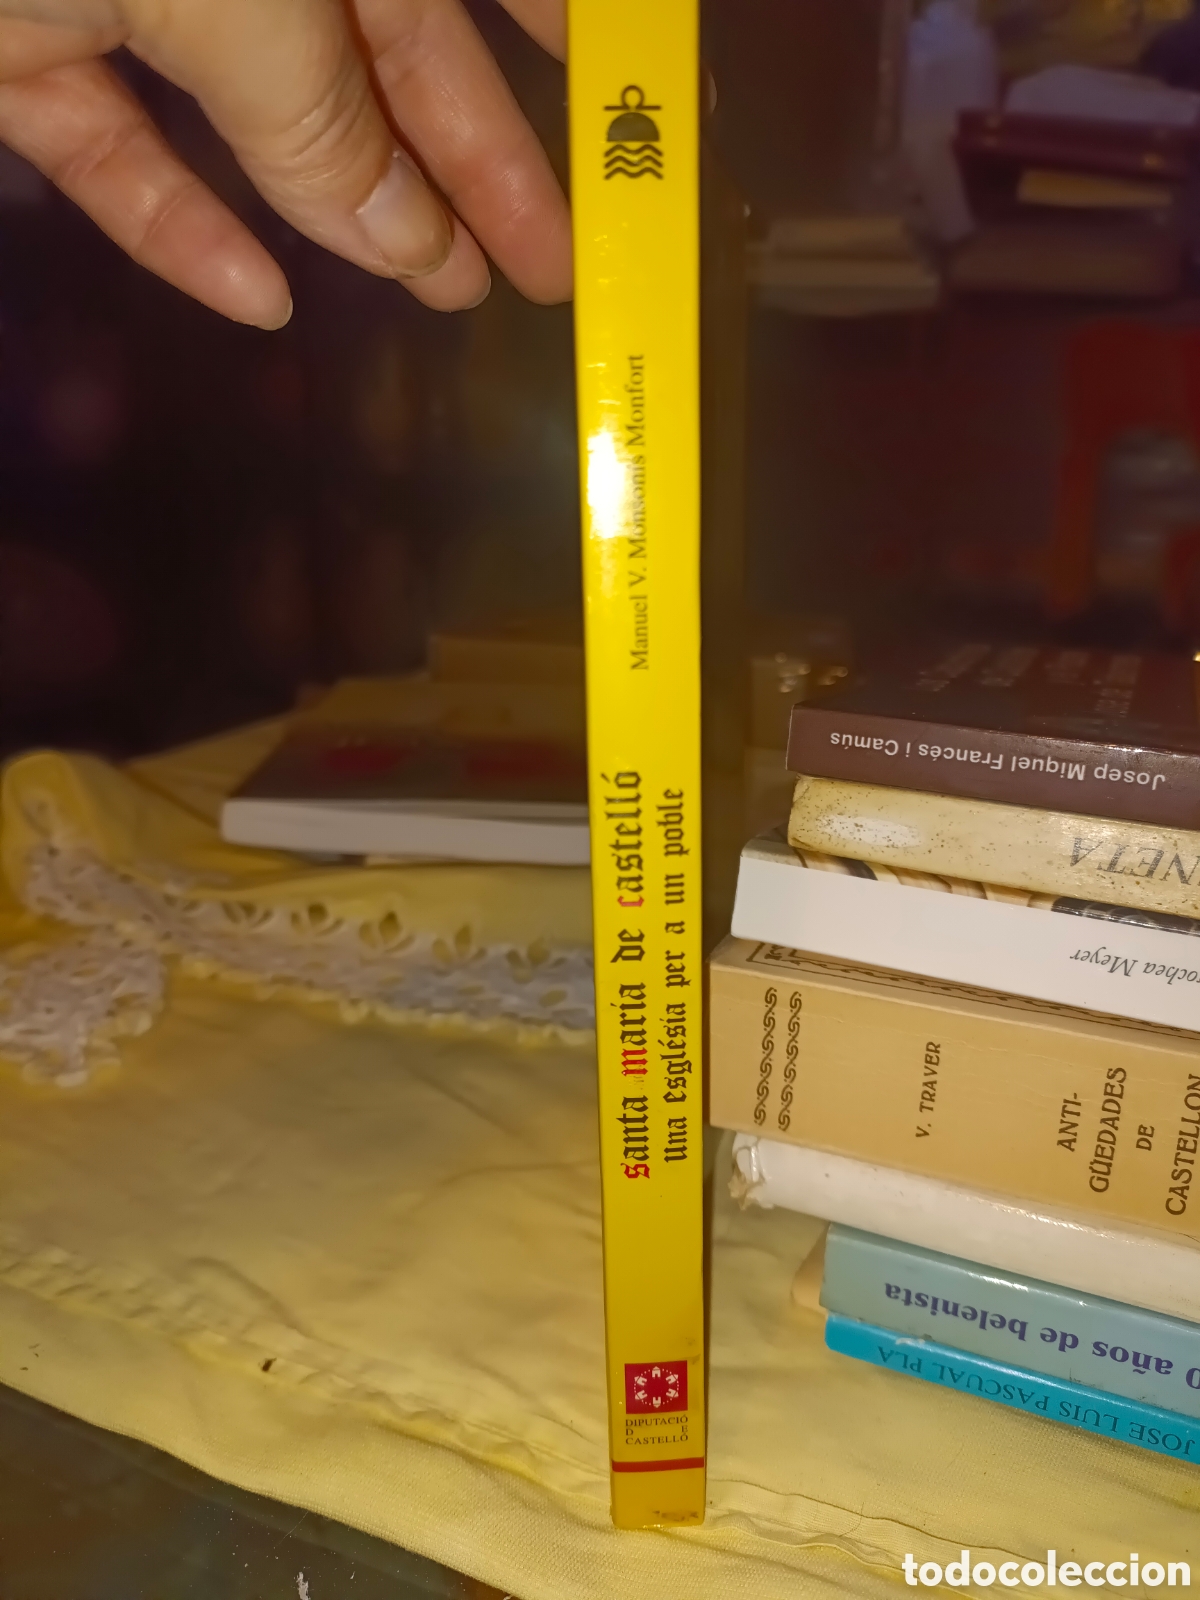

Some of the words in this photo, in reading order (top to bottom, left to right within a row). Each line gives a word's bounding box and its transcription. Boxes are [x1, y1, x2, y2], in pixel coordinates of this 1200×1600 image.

[624, 354, 645, 448] Monfort
[627, 567, 648, 588] V.
[629, 595, 649, 671] Manuel
[829, 732, 899, 757] Camús
[905, 741, 912, 758] i
[918, 742, 1004, 769] Francés
[1010, 756, 1086, 781] Miquel
[1093, 767, 1167, 791] Josep
[656, 787, 690, 857] poble
[1069, 836, 1200, 887] NETA
[664, 872, 685, 906] un
[664, 920, 686, 935] a
[665, 949, 692, 989] per
[1069, 946, 1138, 978] Meyer
[919, 1041, 941, 1114] TRAVER
[915, 1123, 932, 1139] V.
[1056, 1092, 1083, 1152] ANTI-
[1088, 1066, 1128, 1193] GÜEDADES
[1135, 1124, 1155, 1151] DE
[884, 1282, 1029, 1342] belenista
[1039, 1327, 1080, 1353] de
[877, 1346, 923, 1373] PLA
[1092, 1341, 1174, 1375] años
[932, 1362, 1051, 1412] PASCUAL
[625, 1415, 688, 1427] DIPUTACIÓ
[1058, 1400, 1120, 1433] LUIS
[625, 1433, 688, 1445] CASTELLÓ
[1128, 1422, 1196, 1456] JOSE
